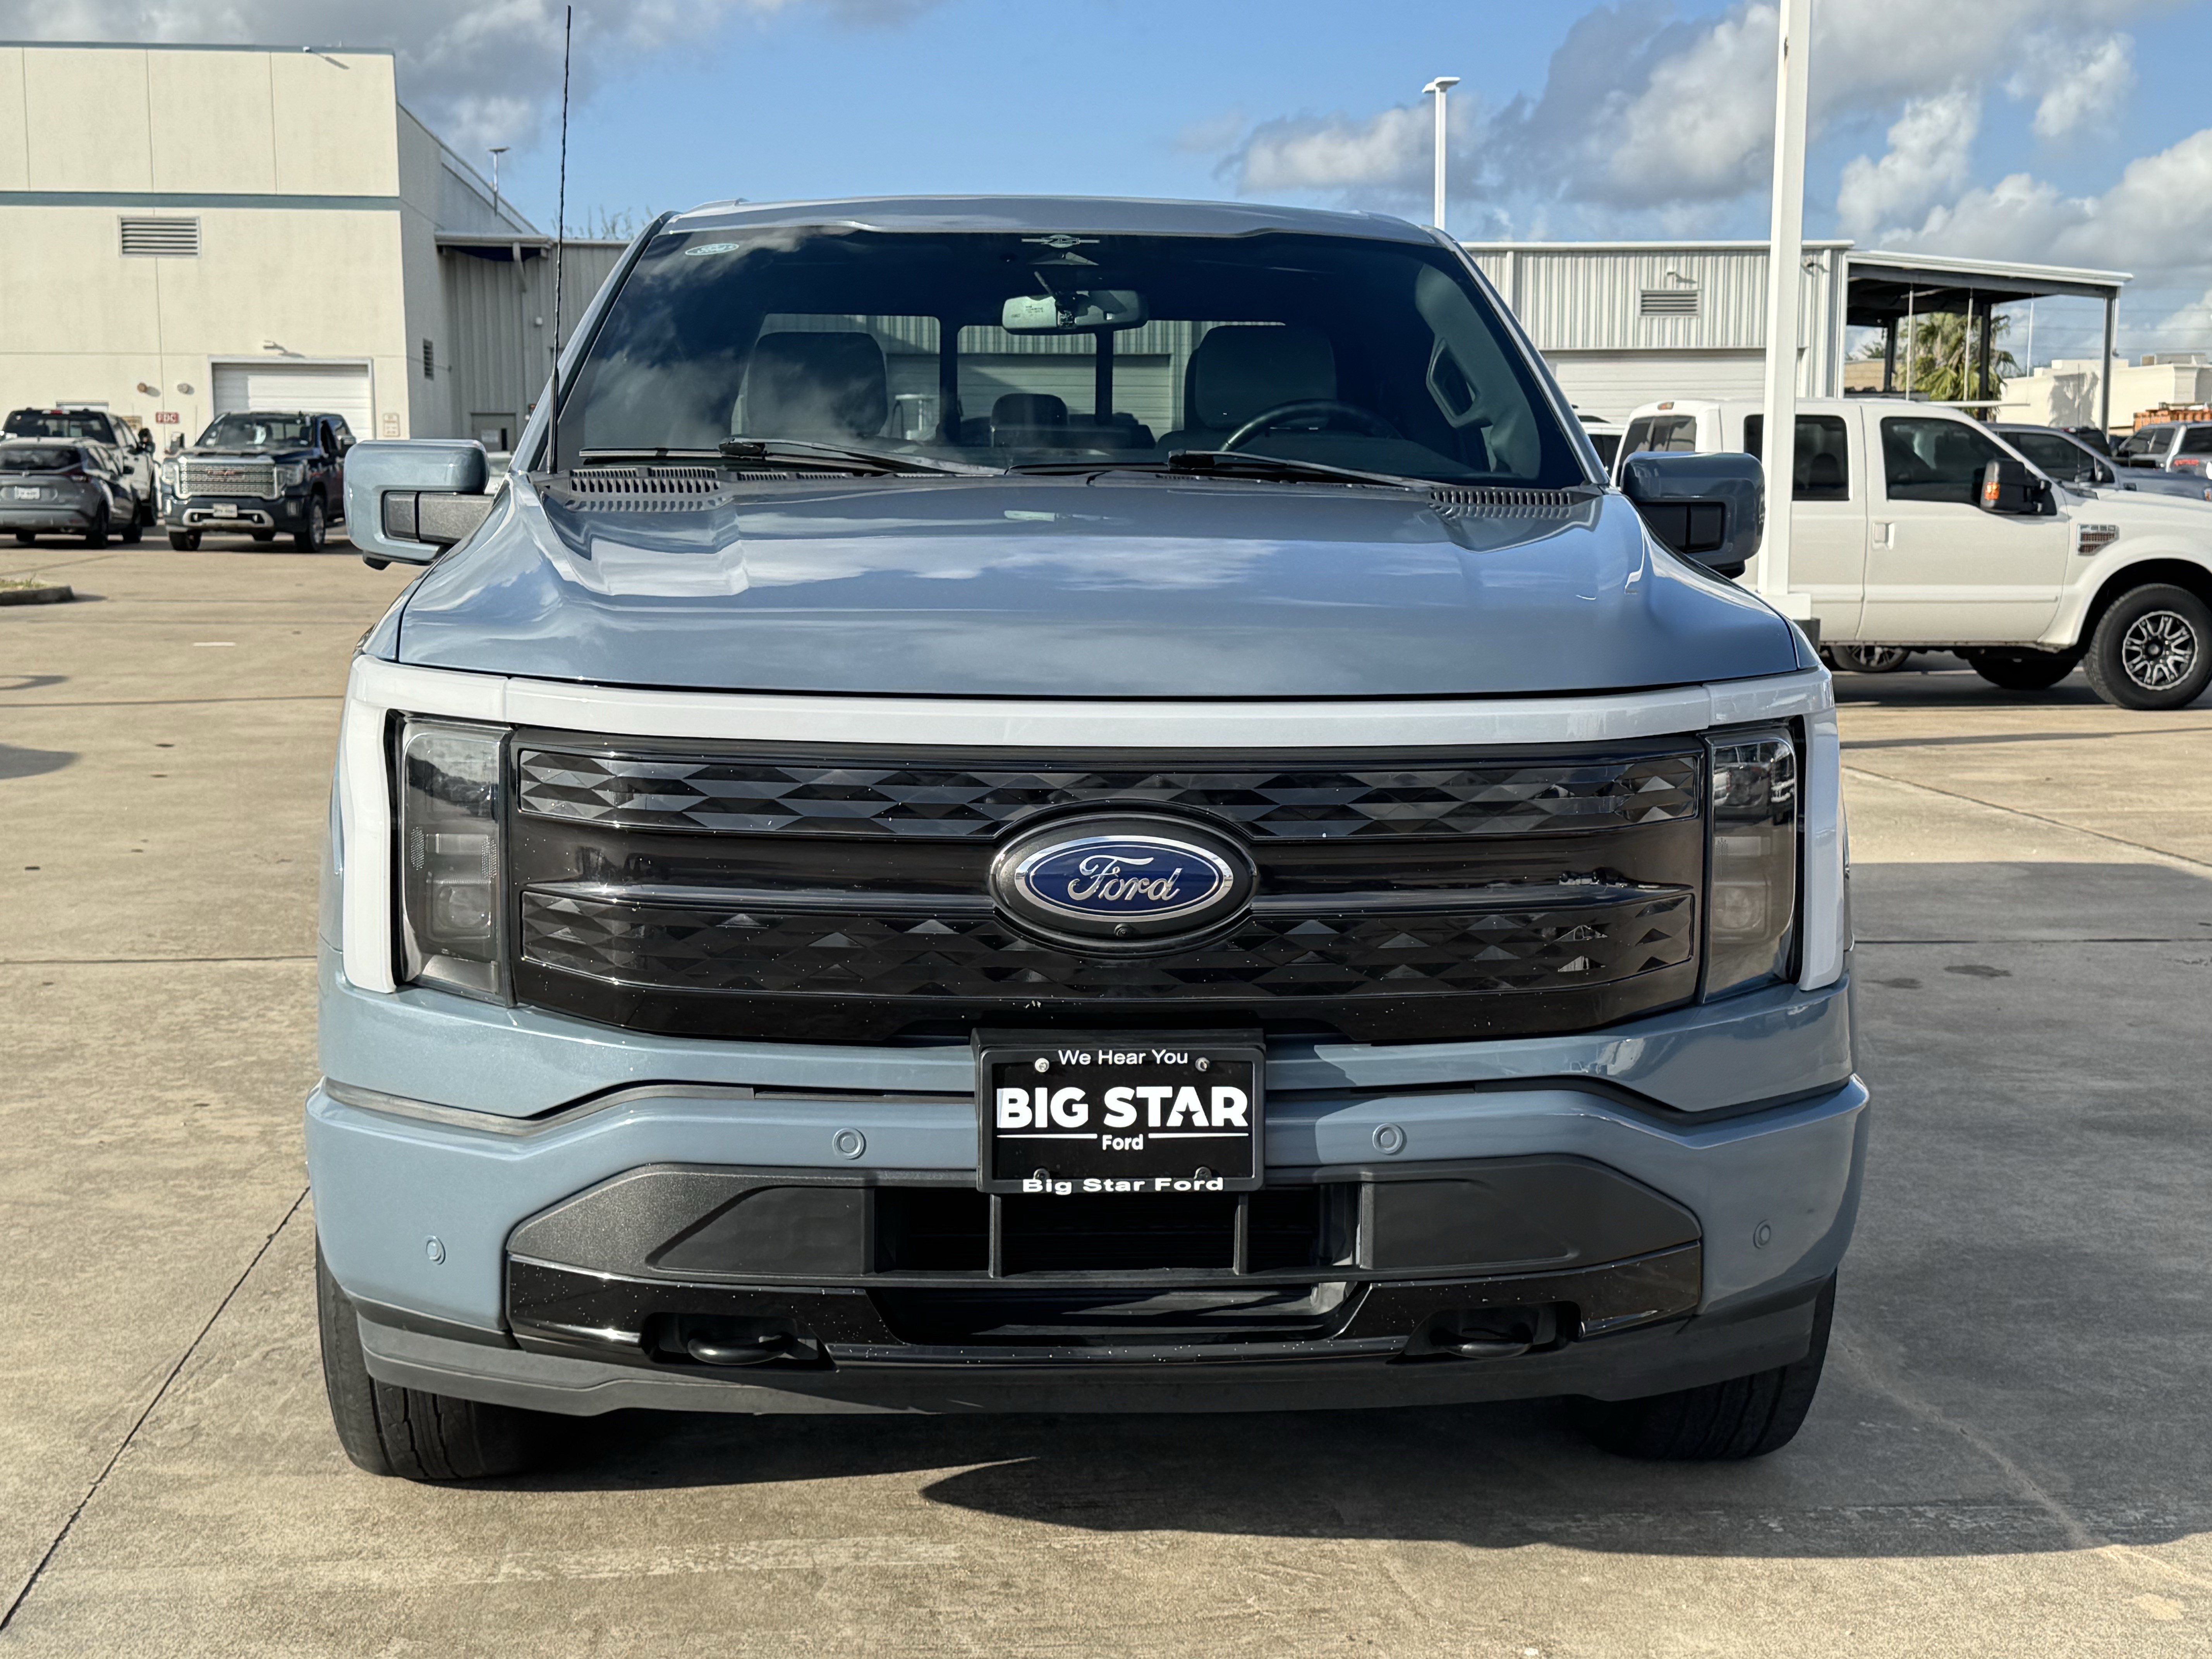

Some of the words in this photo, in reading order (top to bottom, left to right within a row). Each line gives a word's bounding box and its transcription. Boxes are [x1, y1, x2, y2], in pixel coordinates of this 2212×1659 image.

[1067, 855, 1183, 901] Ford
[1058, 1049, 1091, 1065] We
[1098, 1049, 1146, 1065] Hear
[1151, 1049, 1188, 1065] You
[996, 1087, 1089, 1128] BIG
[1103, 1086, 1248, 1128] STAR
[1102, 1134, 1144, 1151] Ford
[1022, 1178, 1072, 1195] Big
[1083, 1178, 1145, 1192] Star
[1155, 1177, 1223, 1192] Ford
